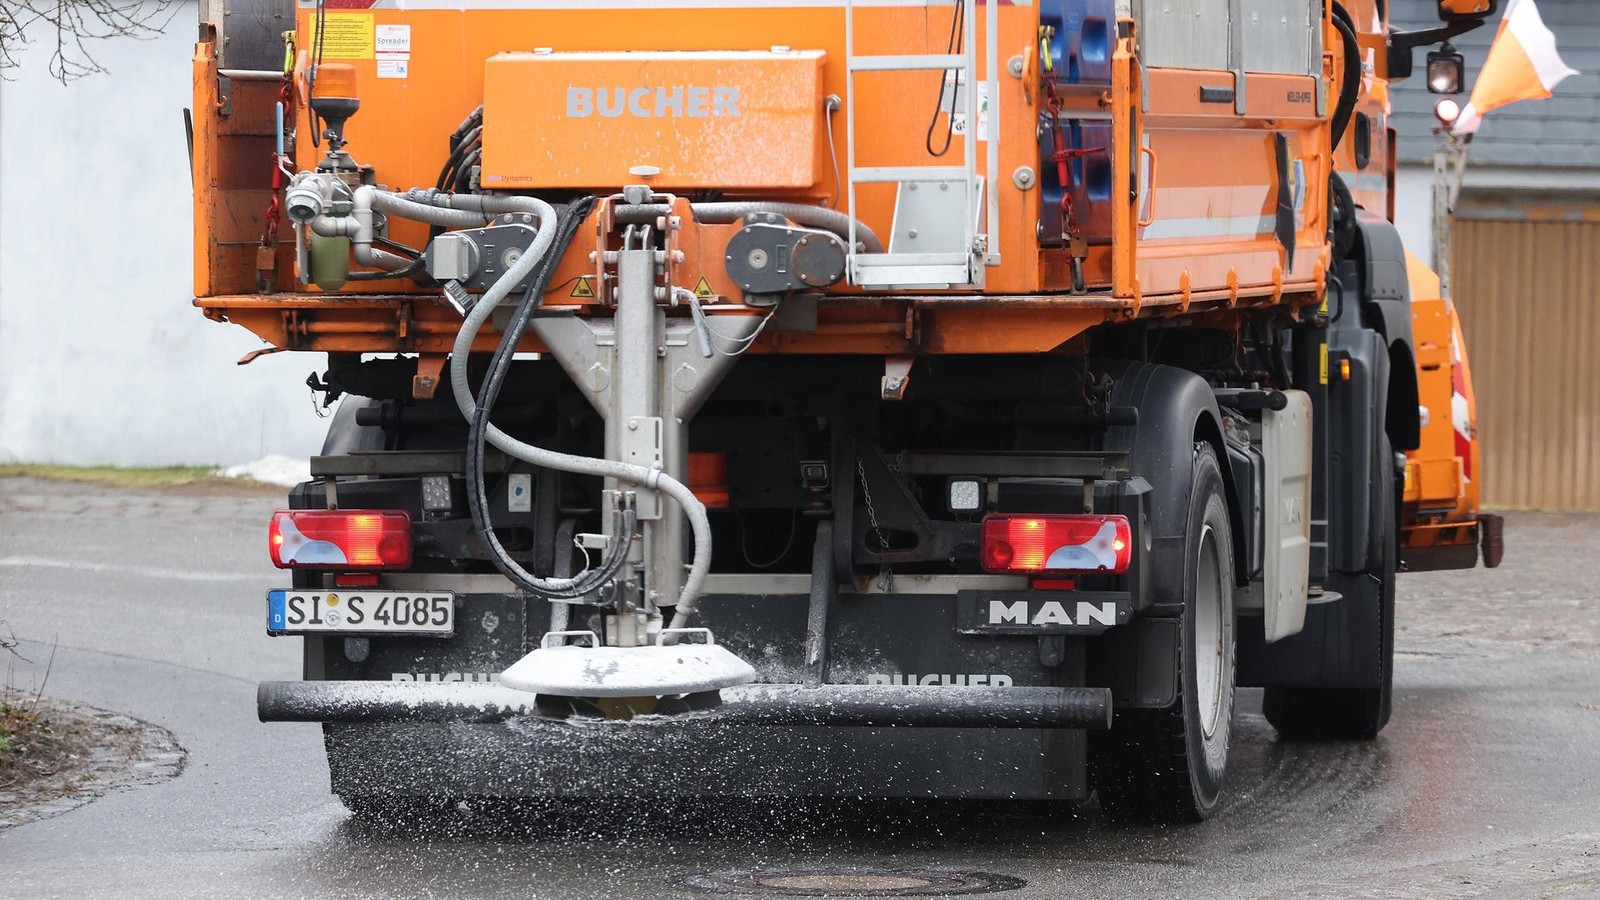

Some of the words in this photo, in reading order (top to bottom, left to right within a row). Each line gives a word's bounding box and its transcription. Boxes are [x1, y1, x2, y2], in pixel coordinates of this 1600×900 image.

[377, 37, 409, 45] Spreader
[566, 86, 741, 118] BUCHER
[274, 614, 281, 623] D
[287, 596, 323, 625] SI
[346, 596, 365, 625] S
[373, 596, 450, 626] 4085
[989, 600, 1117, 626] MAN
